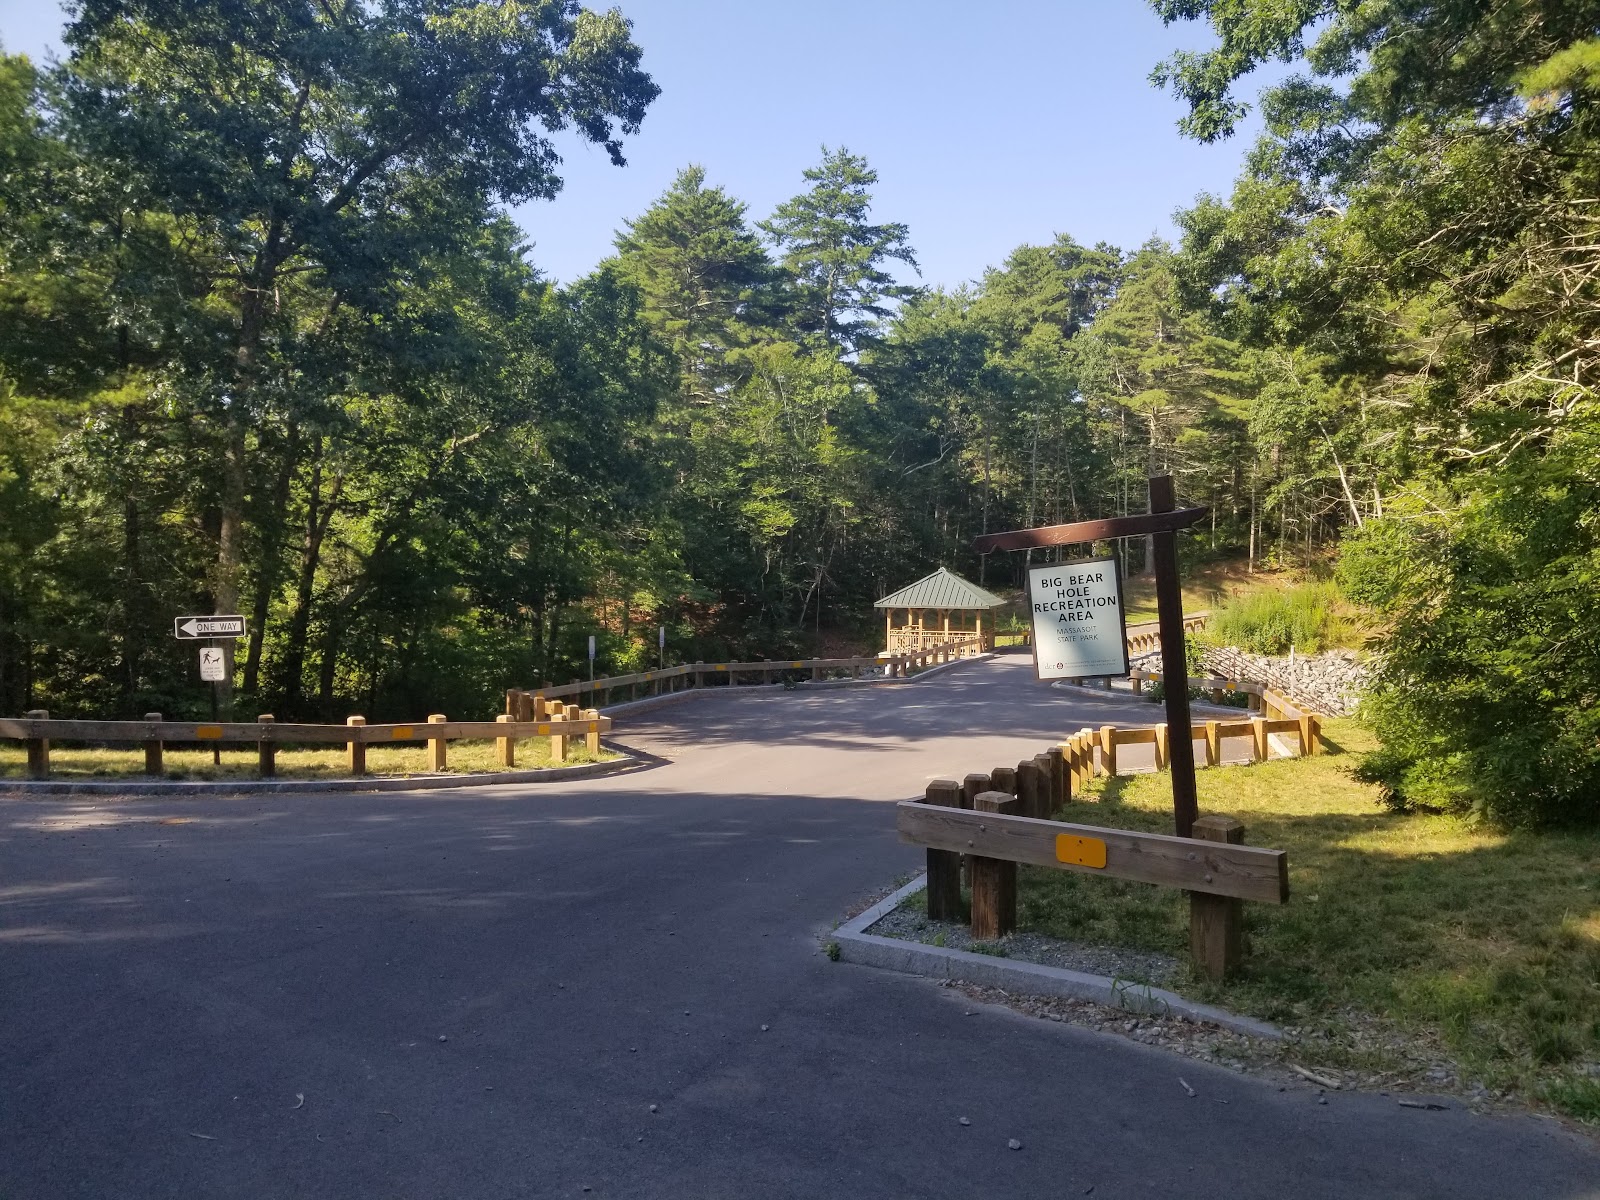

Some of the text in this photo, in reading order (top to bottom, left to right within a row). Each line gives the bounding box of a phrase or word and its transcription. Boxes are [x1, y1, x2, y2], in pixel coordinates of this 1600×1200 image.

[1042, 573, 1103, 588] BIG BEAR
[1057, 587, 1090, 598] HOLE
[1034, 596, 1116, 612] RECREATION
[1058, 611, 1094, 622] AREA
[197, 622, 237, 632] ONE WAY
[1057, 626, 1097, 635] MASSASOIT
[1057, 635, 1076, 643] STATE
